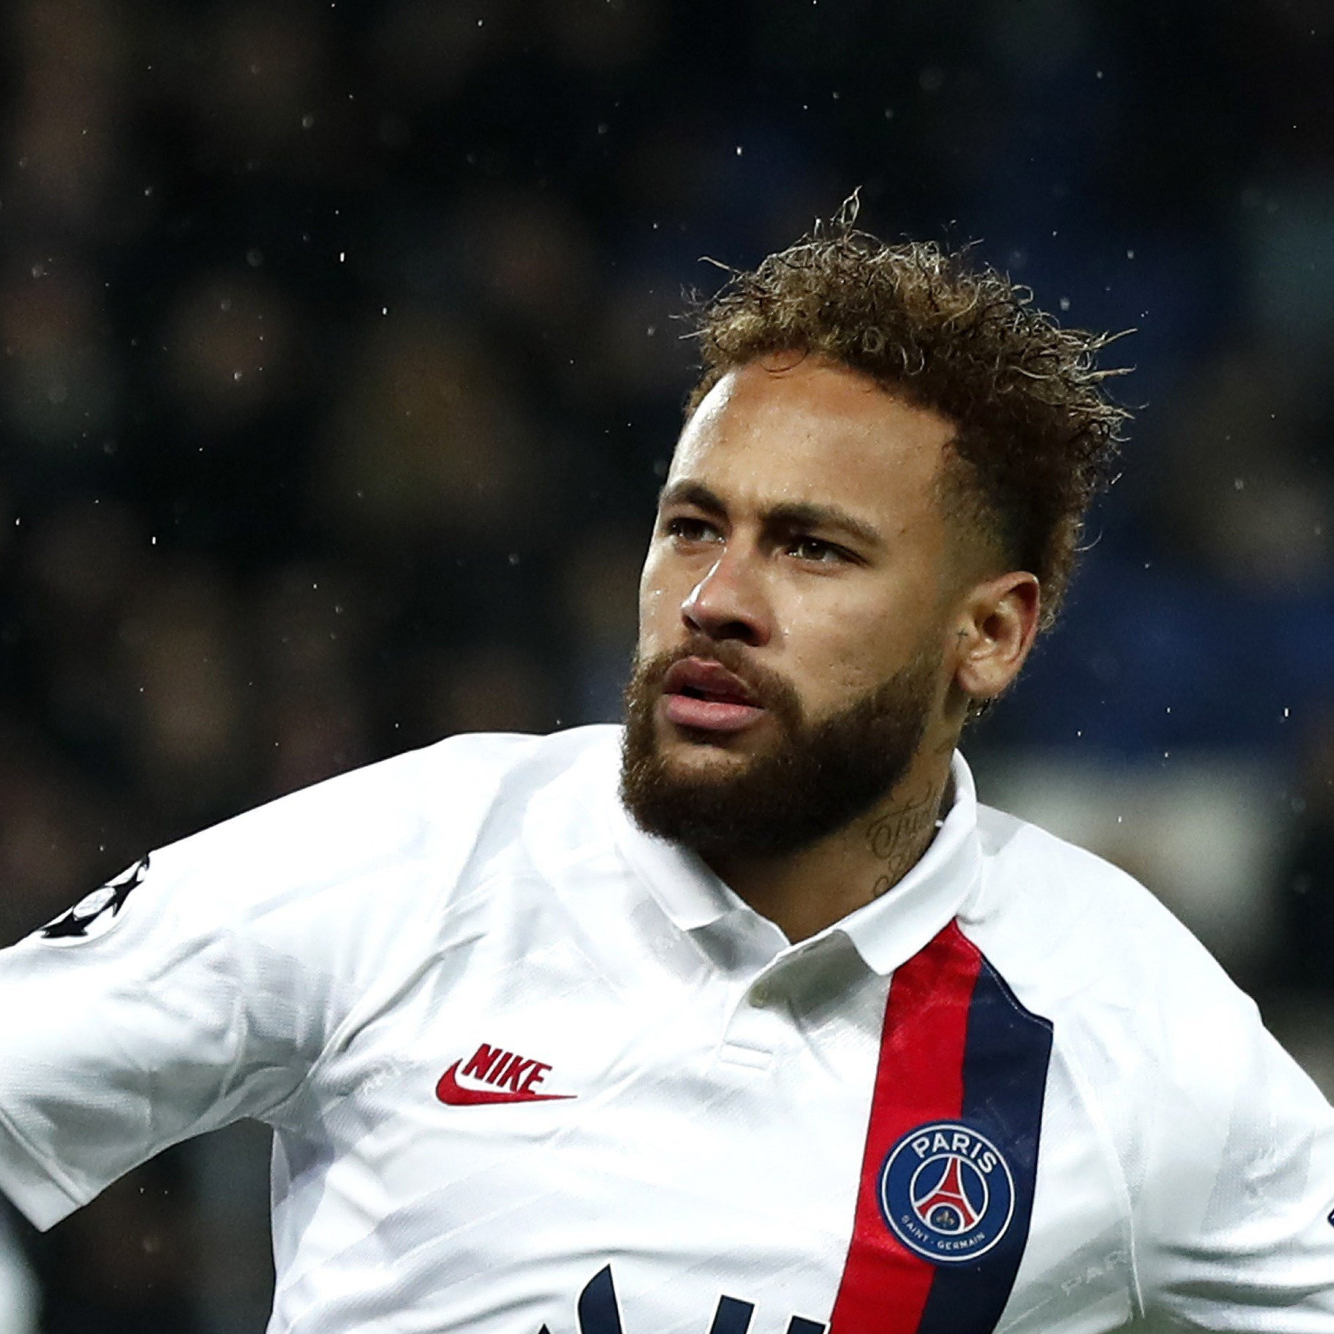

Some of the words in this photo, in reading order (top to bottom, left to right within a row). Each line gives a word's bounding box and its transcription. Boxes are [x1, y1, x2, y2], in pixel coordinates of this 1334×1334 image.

[461, 1043, 552, 1095] NIKE
[911, 1132, 998, 1174] PARIS
[900, 1214, 930, 1244] SAINT
[936, 1231, 986, 1251] GERMAIN
